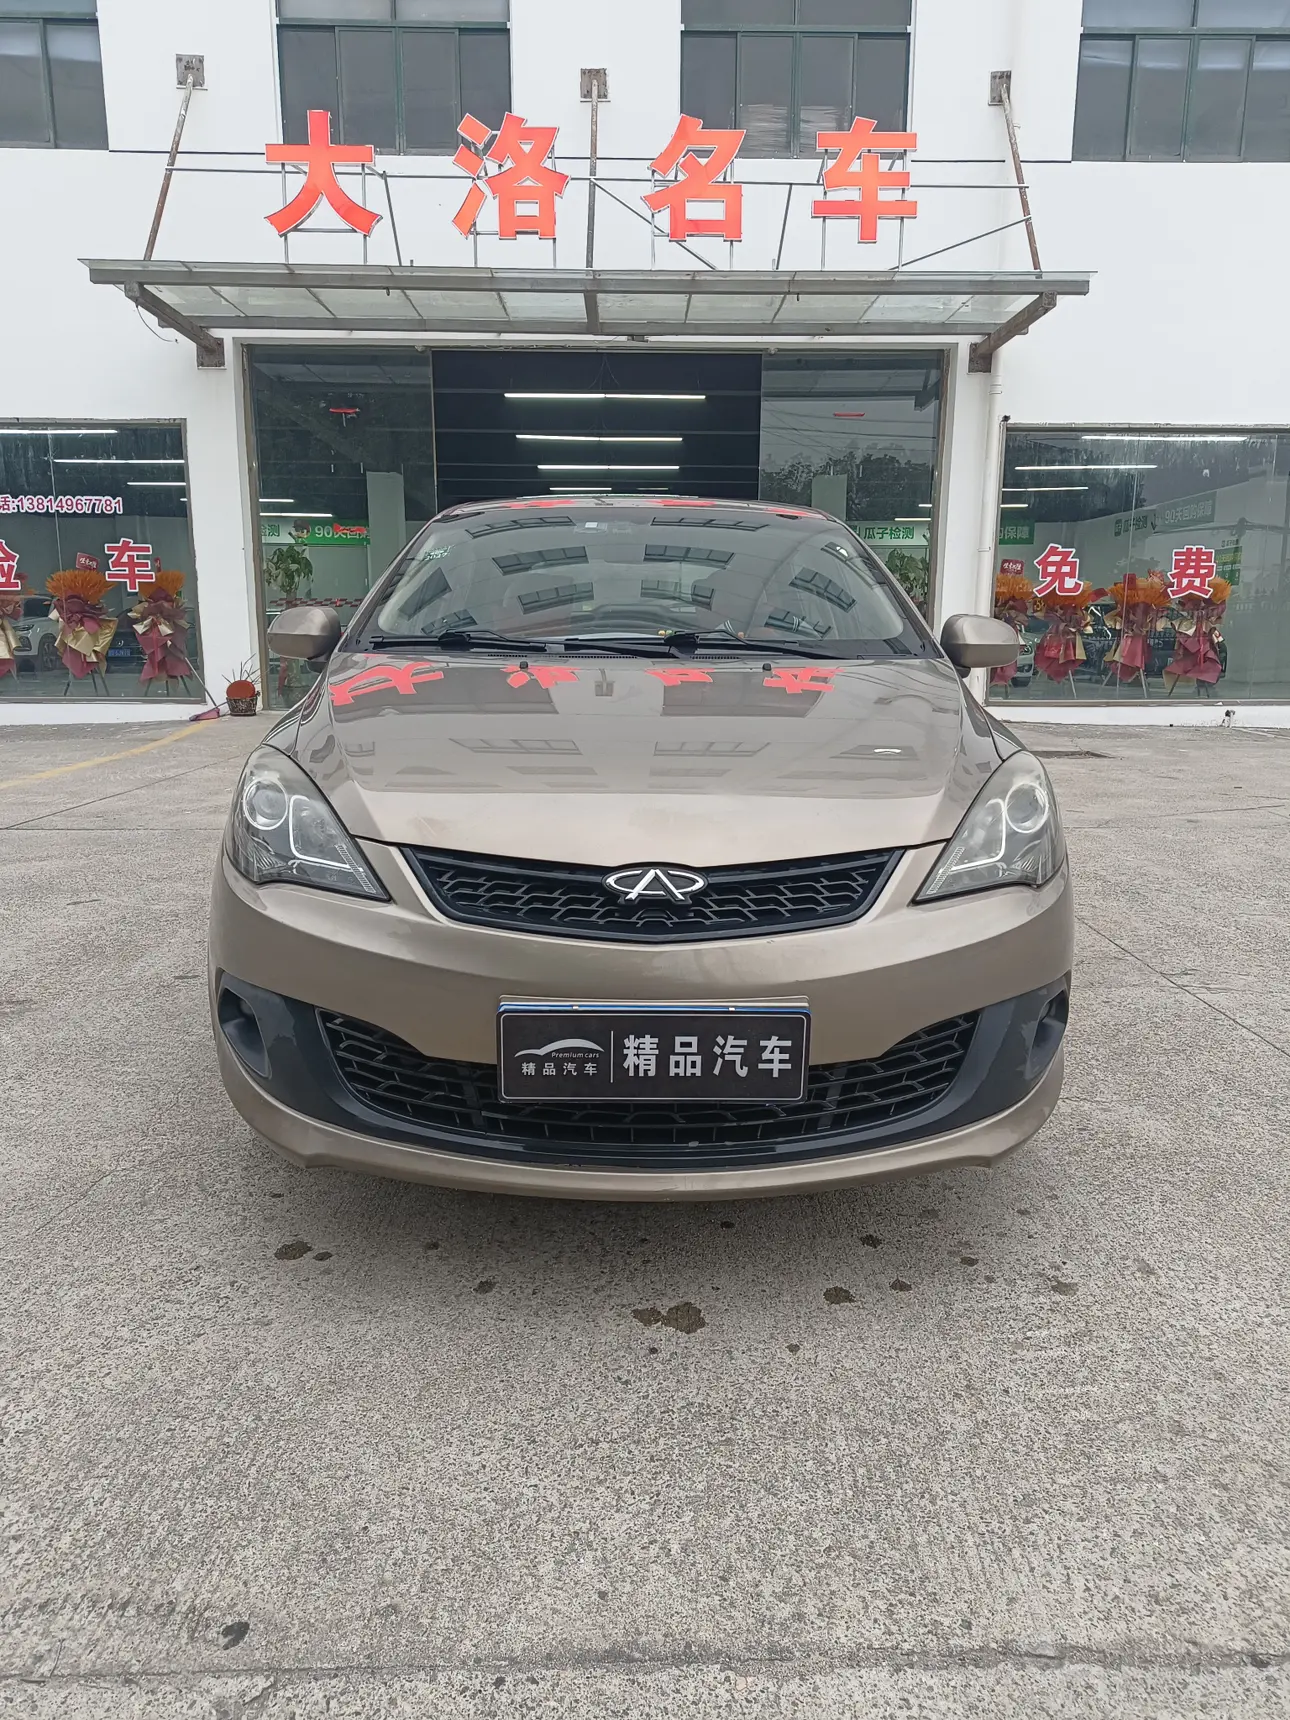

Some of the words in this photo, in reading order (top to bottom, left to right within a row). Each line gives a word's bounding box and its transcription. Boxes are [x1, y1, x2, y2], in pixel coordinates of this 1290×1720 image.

[264, 110, 918, 244] 大洛名车
[864, 526, 915, 540] 瓜子检测
[1033, 543, 1217, 599] 免费
[521, 1062, 598, 1076] 精品汽车
[623, 1034, 793, 1078] 精品汽车
